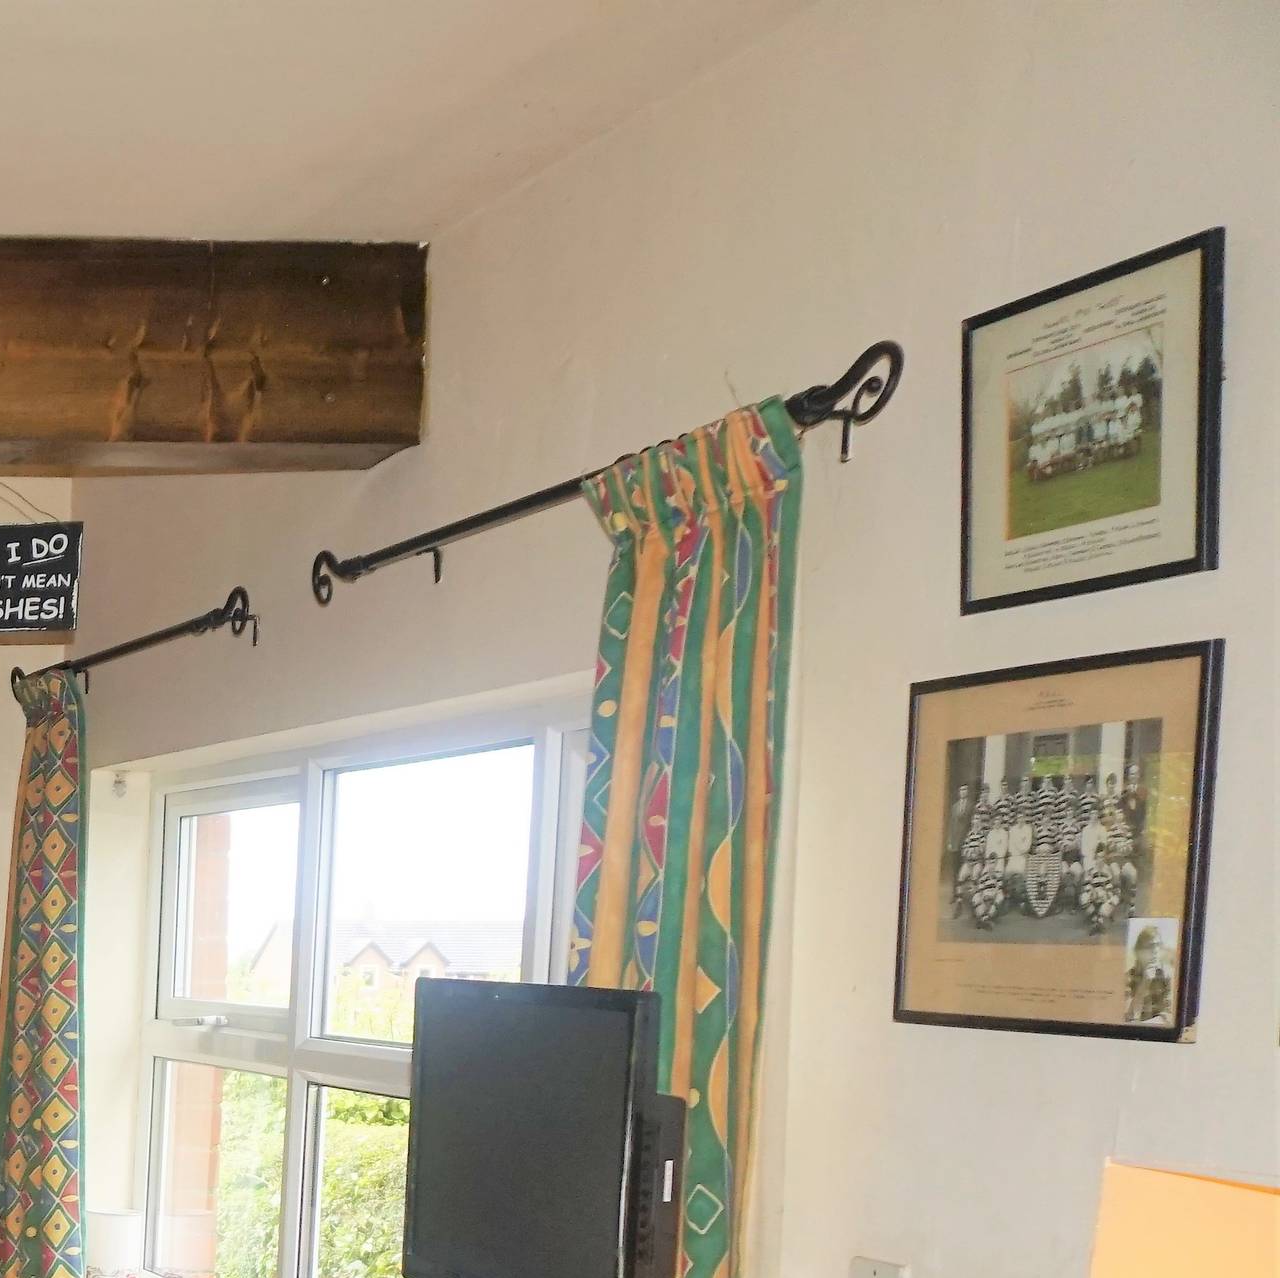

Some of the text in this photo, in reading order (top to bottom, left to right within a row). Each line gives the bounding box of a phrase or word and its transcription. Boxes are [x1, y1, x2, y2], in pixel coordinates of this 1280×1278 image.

[6, 542, 21, 563] I
[31, 533, 68, 560] DO
[21, 572, 71, 589] MEAN
